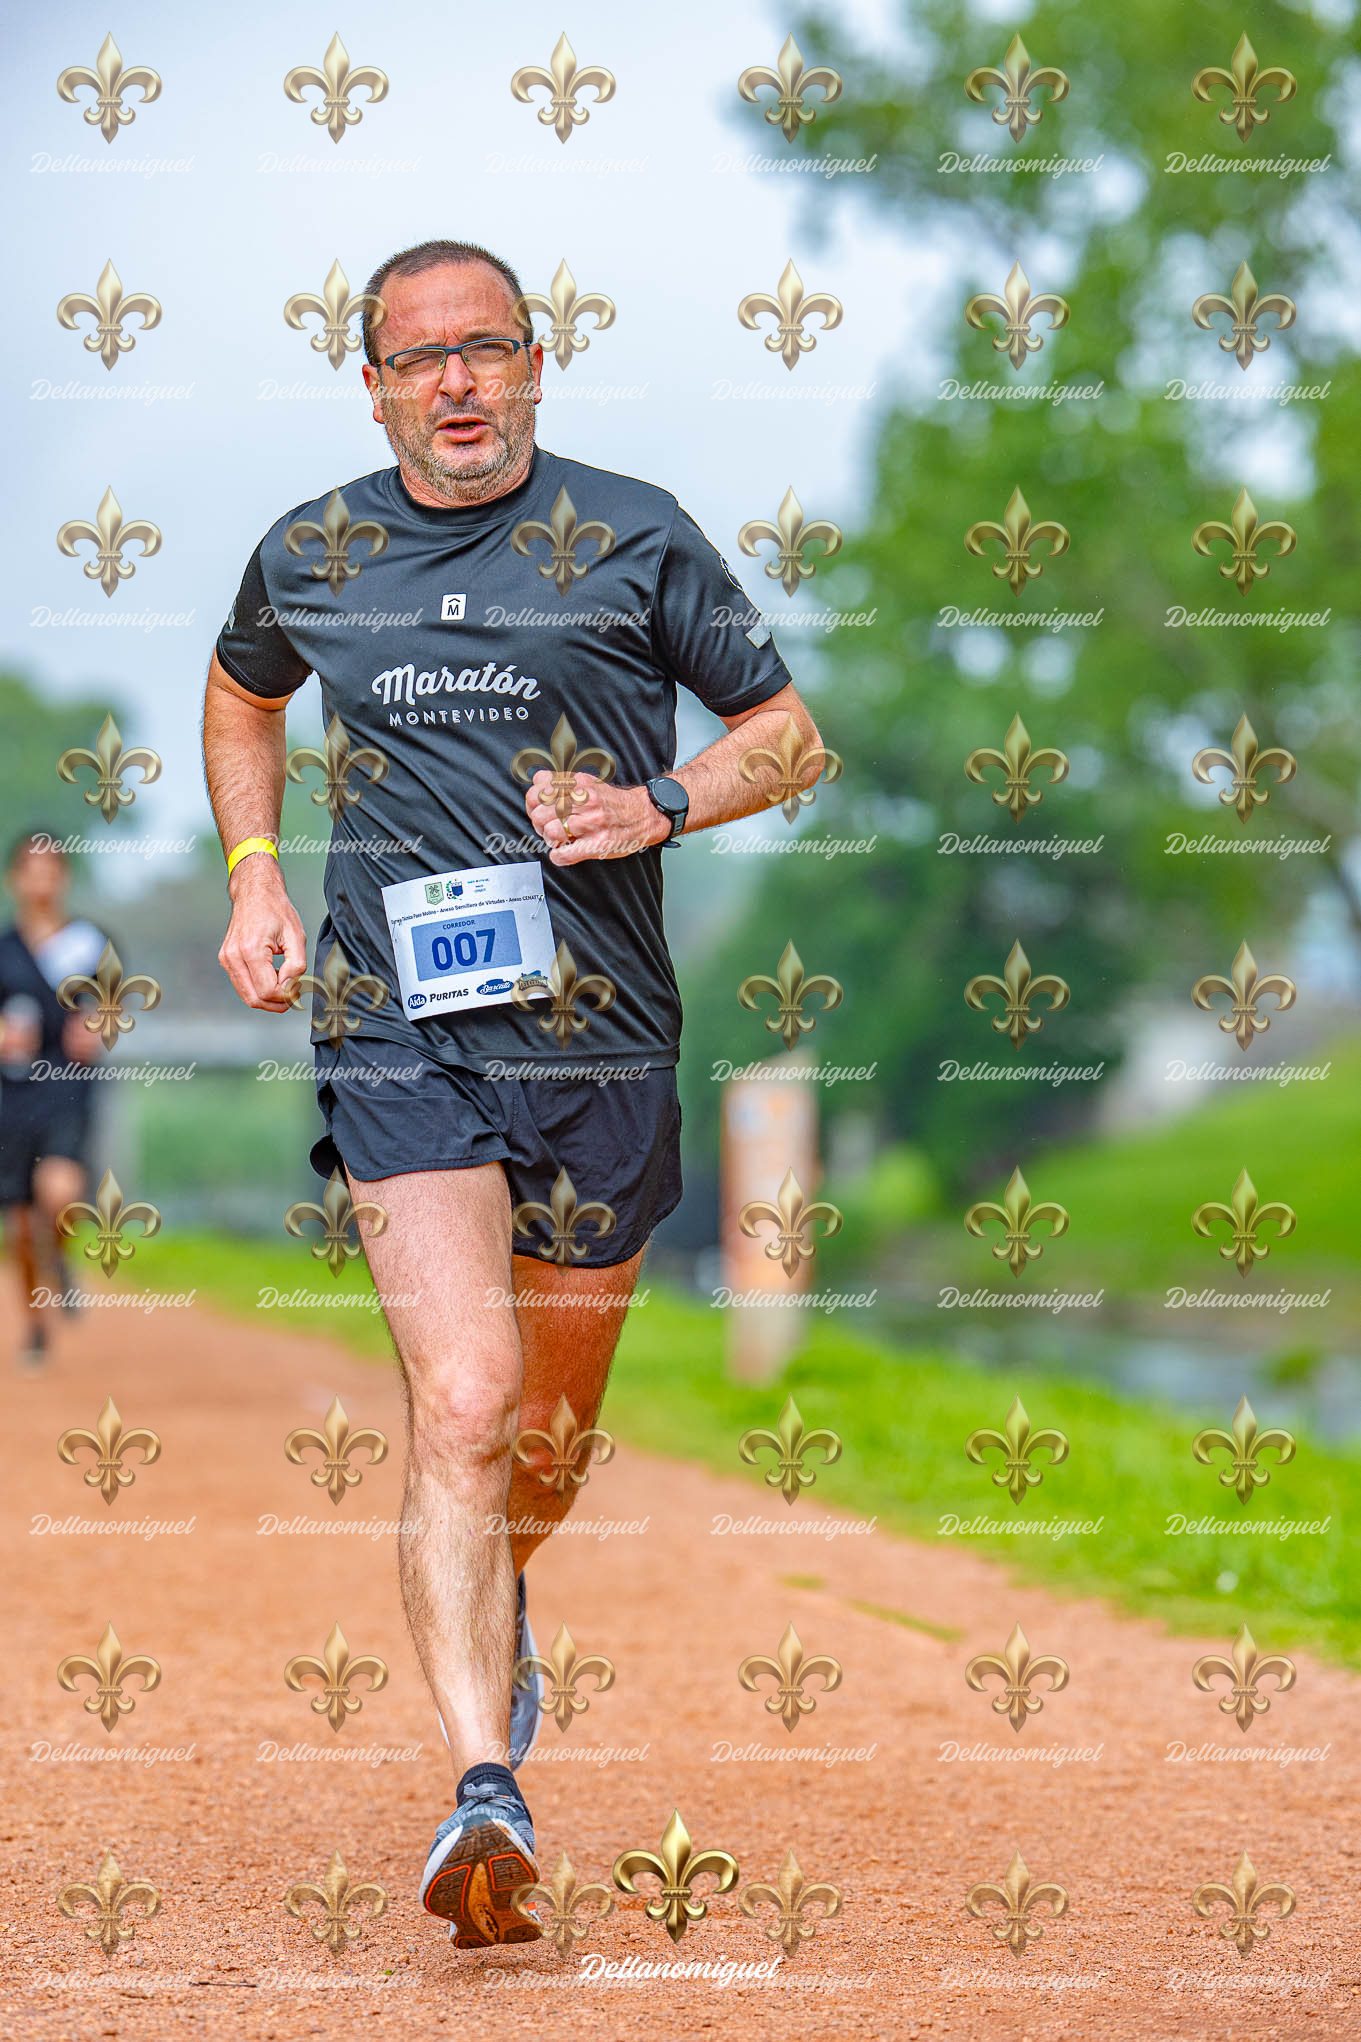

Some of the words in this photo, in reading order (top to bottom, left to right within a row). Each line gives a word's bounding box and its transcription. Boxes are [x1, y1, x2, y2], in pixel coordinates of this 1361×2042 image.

[371, 662, 542, 706] Maratón
[389, 706, 529, 727] MONTEVIDEO
[485, 897, 505, 906] Virtudes
[442, 919, 476, 930] CORREDOR
[432, 928, 496, 971] 007
[429, 988, 469, 1003] PURITAS
